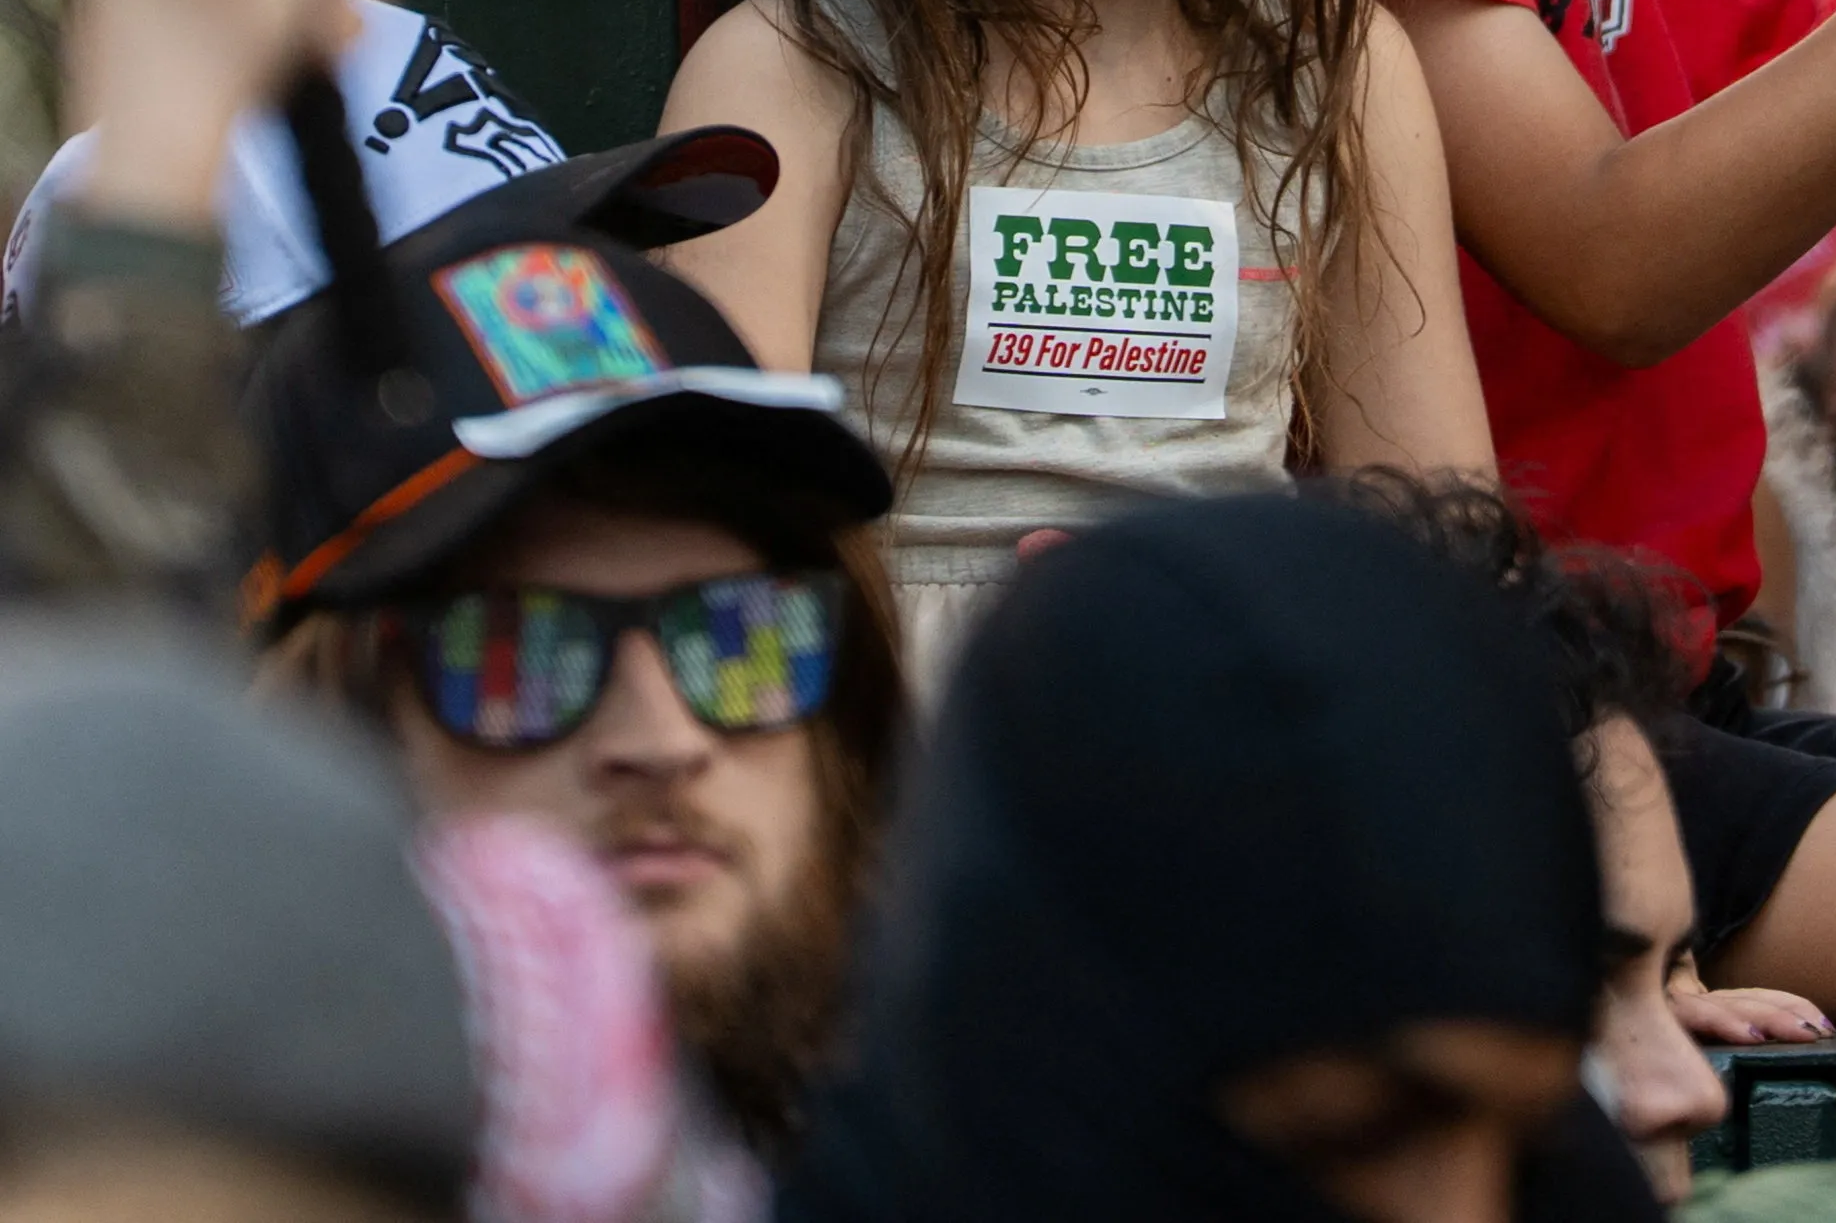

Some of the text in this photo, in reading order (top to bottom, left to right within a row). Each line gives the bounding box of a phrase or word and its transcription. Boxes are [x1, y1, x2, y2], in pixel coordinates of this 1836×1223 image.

[993, 214, 1215, 288] FREE
[992, 282, 1214, 322] PALESTINE
[987, 332, 1207, 375] 139 For Palestine
